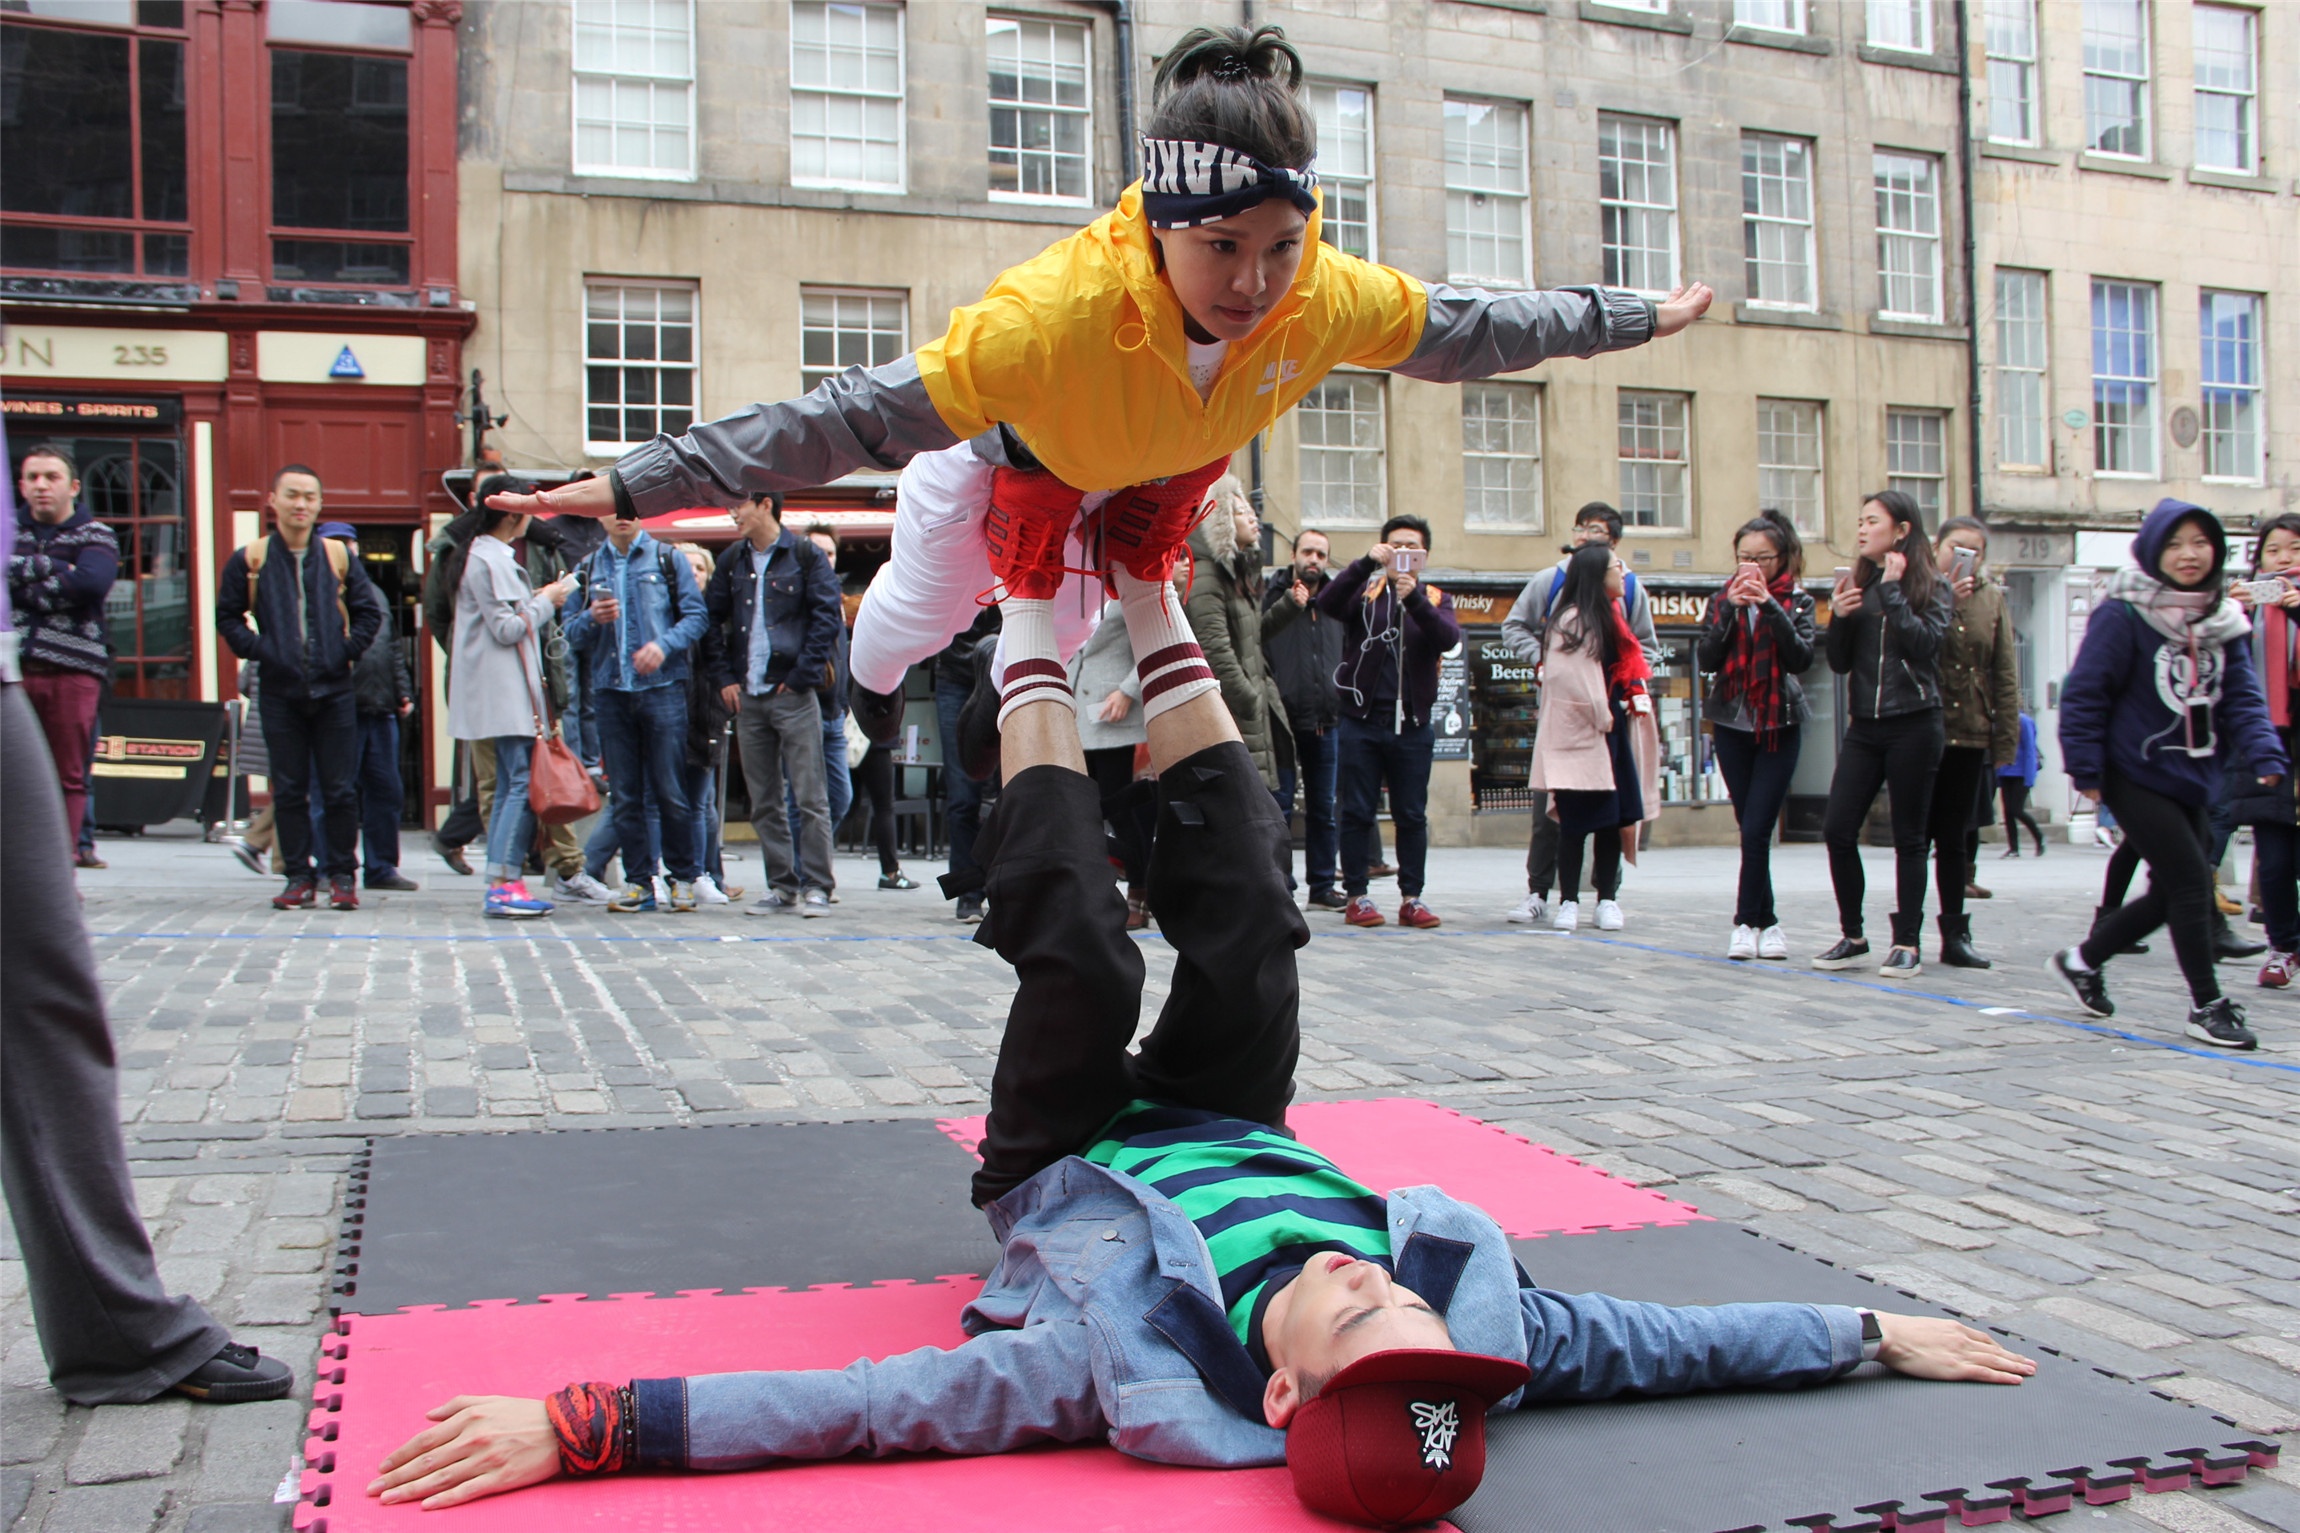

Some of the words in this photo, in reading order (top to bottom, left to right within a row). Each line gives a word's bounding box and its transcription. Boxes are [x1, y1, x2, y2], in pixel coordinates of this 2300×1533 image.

[115, 345, 168, 366] 235
[77, 403, 159, 419] SPIRITS
[2018, 537, 2050, 559] 219
[1491, 663, 1535, 680] Beers
[1653, 662, 1671, 677] alt
[126, 742, 199, 756] STATION
